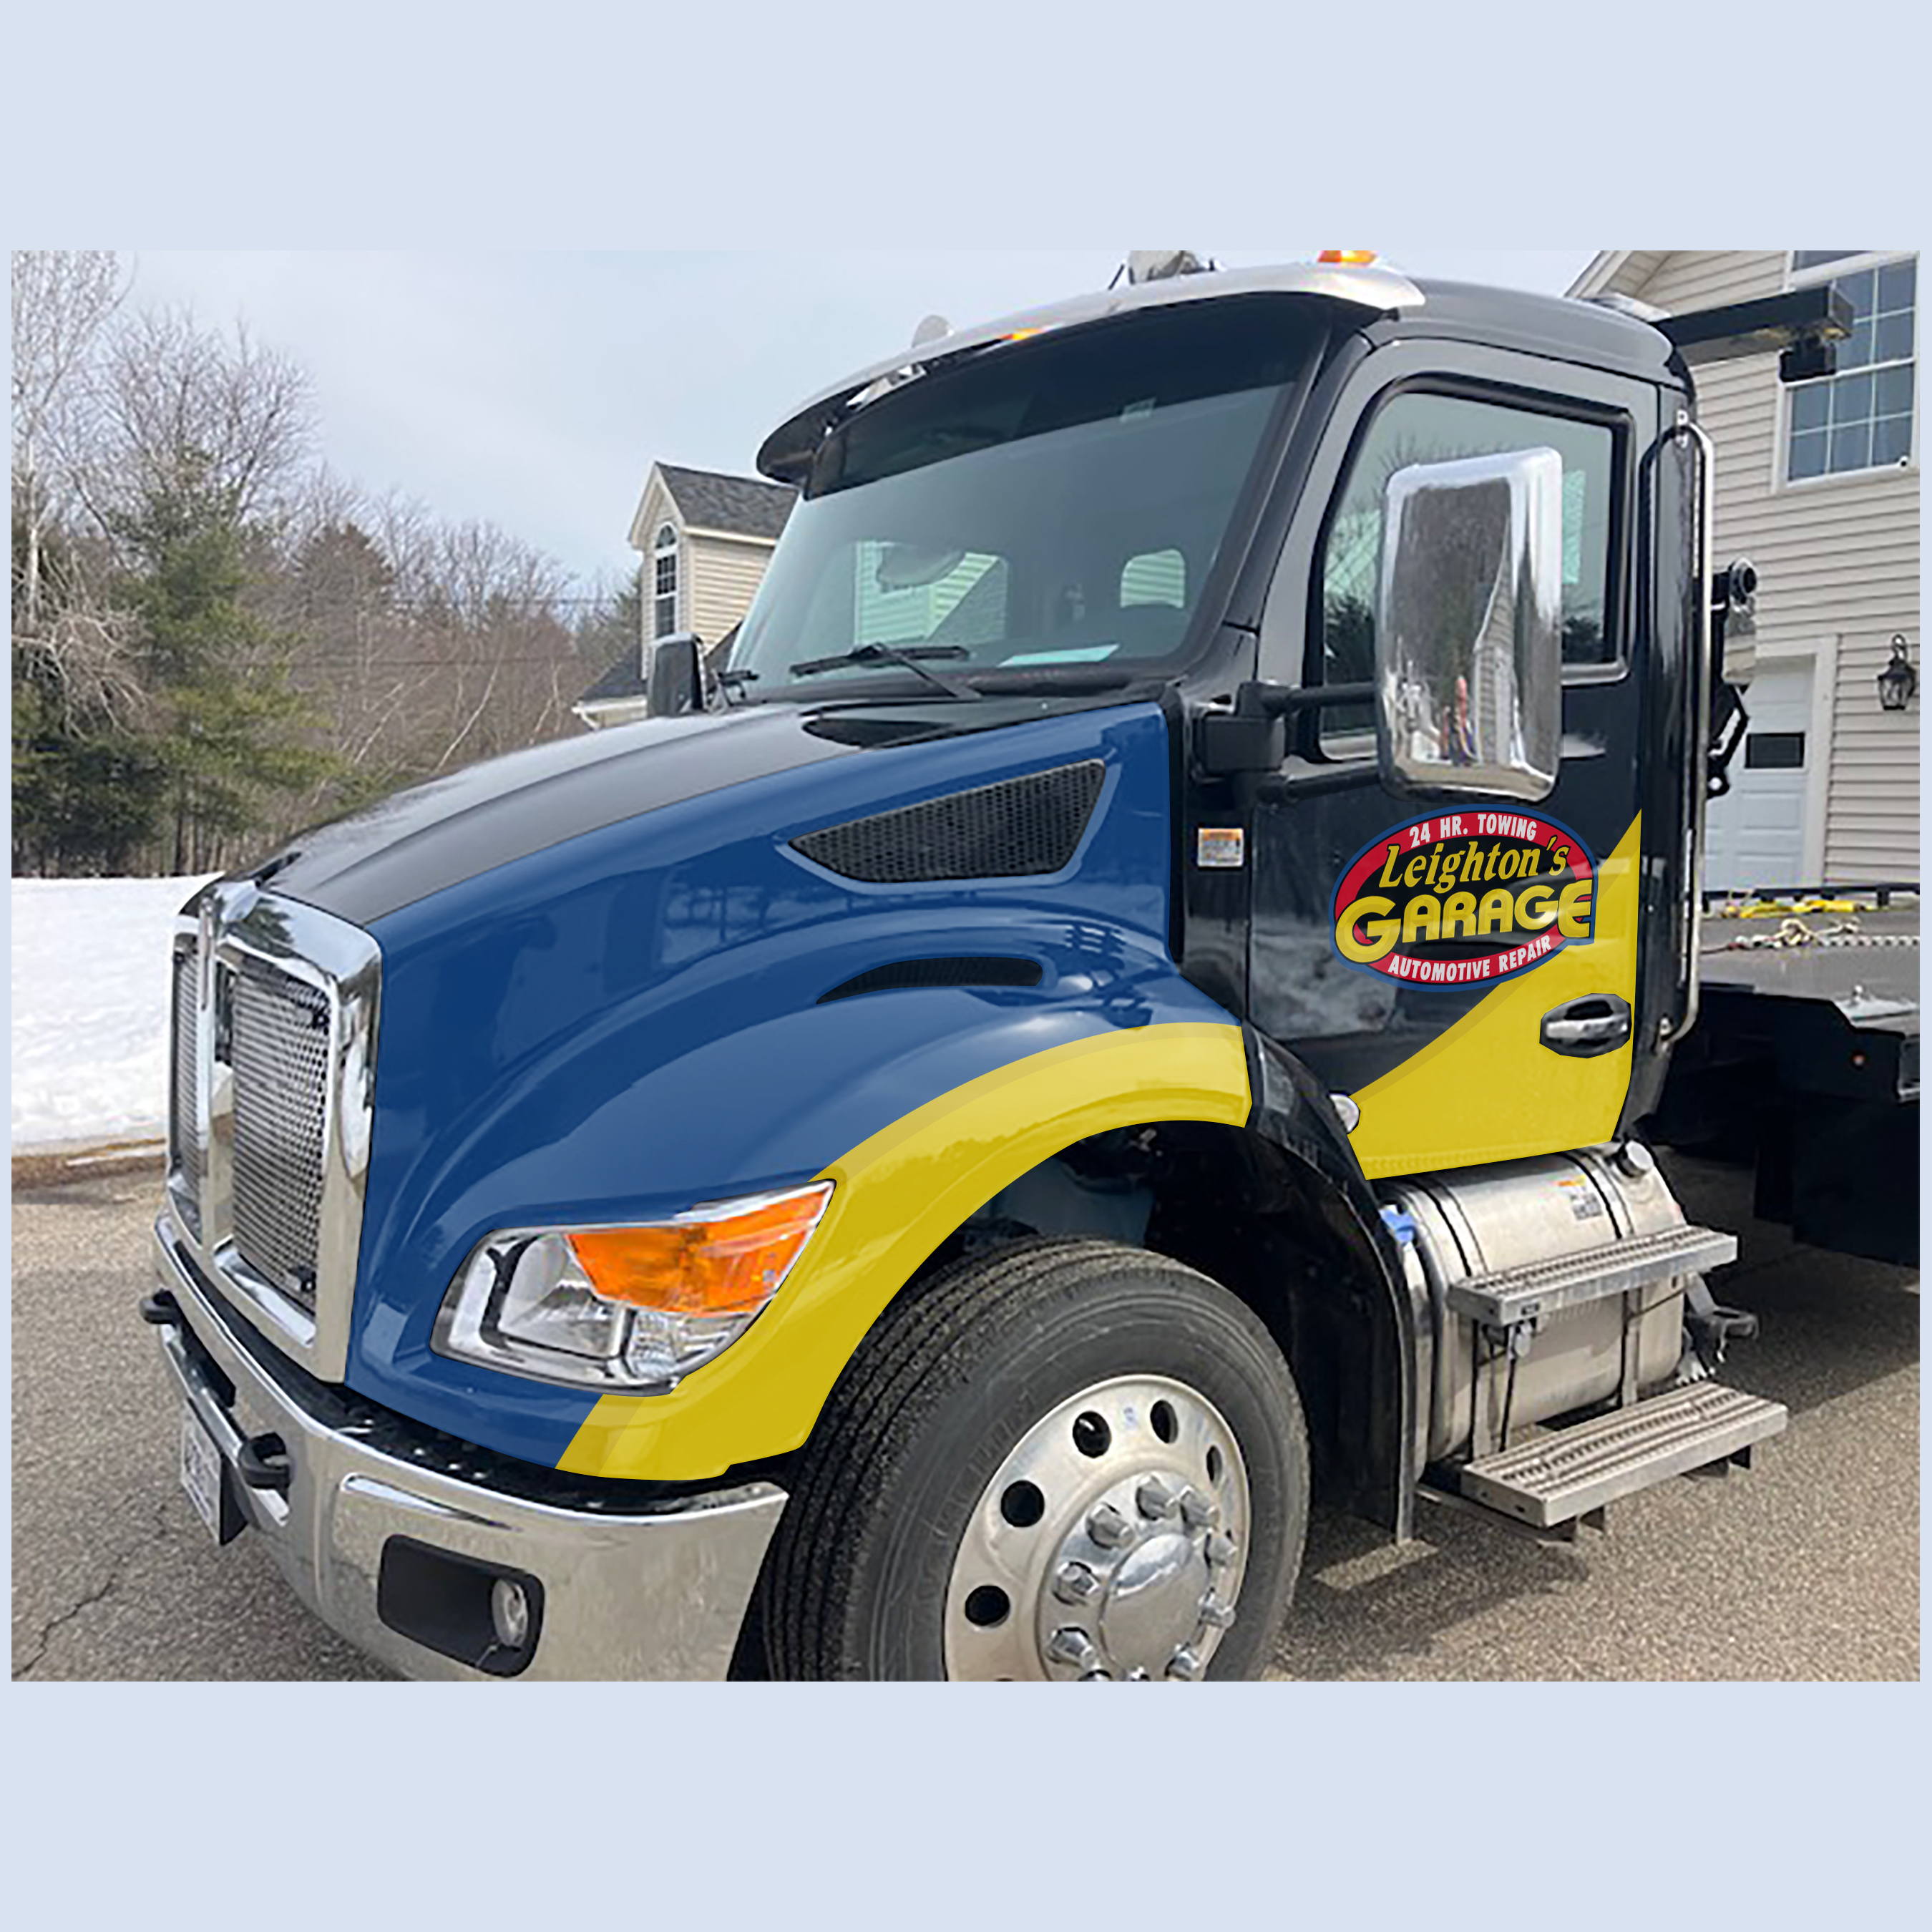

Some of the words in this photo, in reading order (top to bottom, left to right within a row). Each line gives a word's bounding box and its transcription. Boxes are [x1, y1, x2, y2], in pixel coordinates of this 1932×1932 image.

[1410, 823, 1430, 849] 24
[1440, 817, 1468, 839] HR.
[1478, 814, 1537, 841] TOWING
[1380, 836, 1570, 893] Leighton's
[1336, 879, 1592, 963] GARAGE
[1388, 955, 1490, 982] AUTOMOTIVE
[1499, 935, 1551, 972] REPAIR
